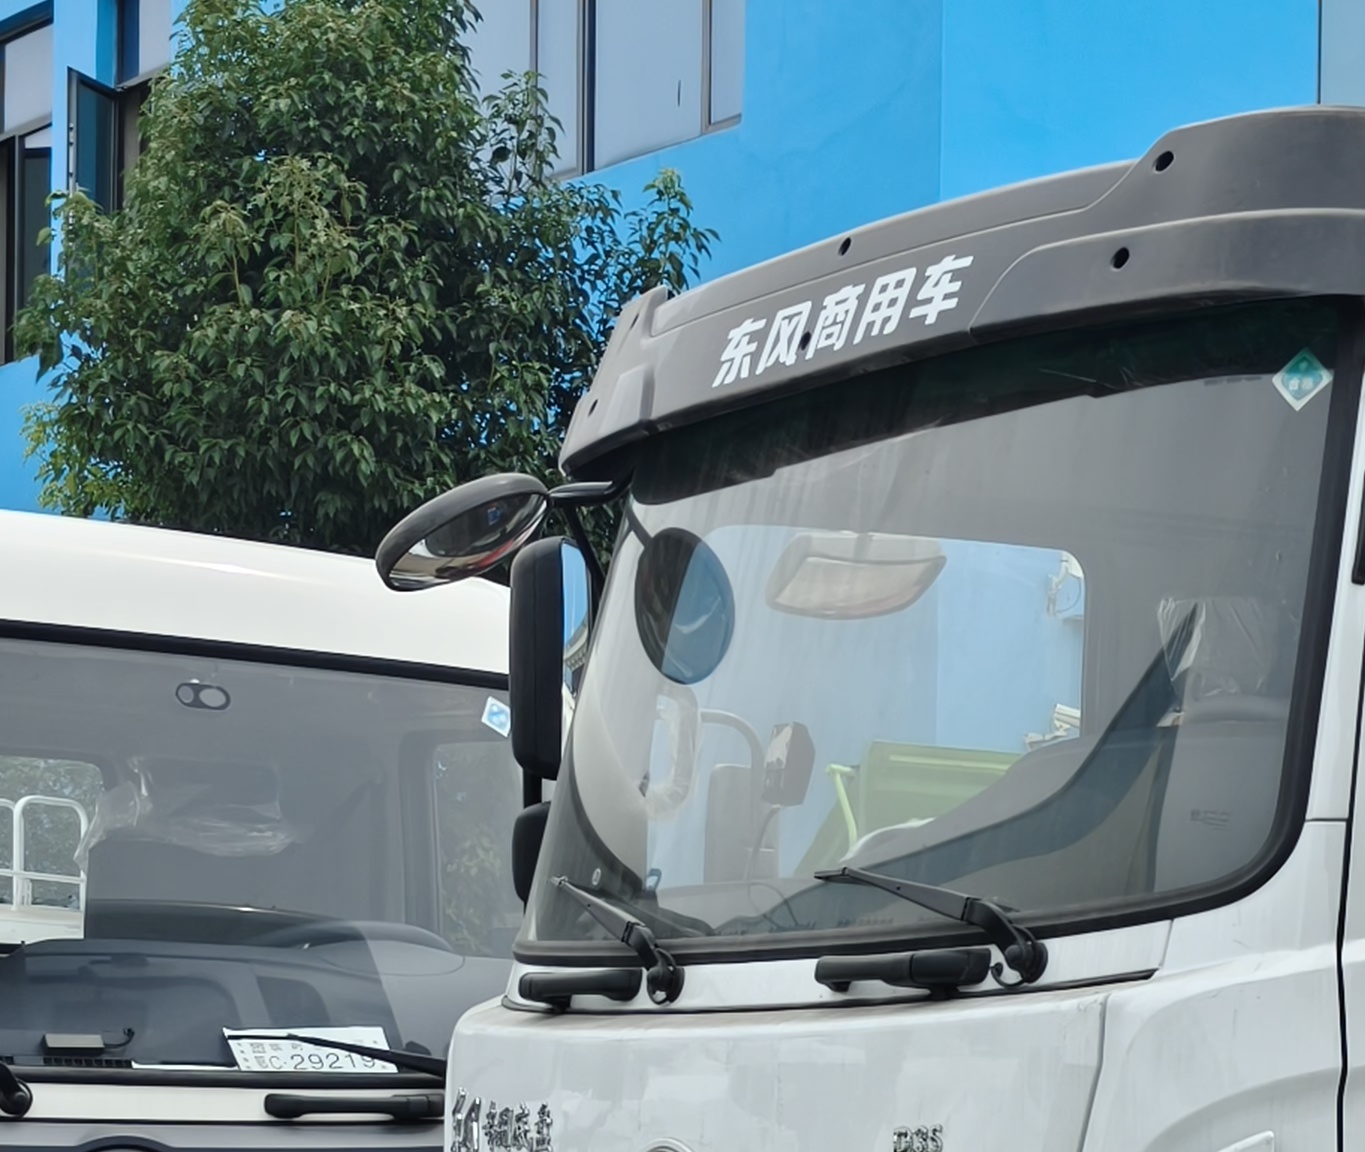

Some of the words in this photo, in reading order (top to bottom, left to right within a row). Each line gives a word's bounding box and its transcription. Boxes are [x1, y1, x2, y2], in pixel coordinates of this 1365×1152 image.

[711, 254, 975, 389] 东风商用车
